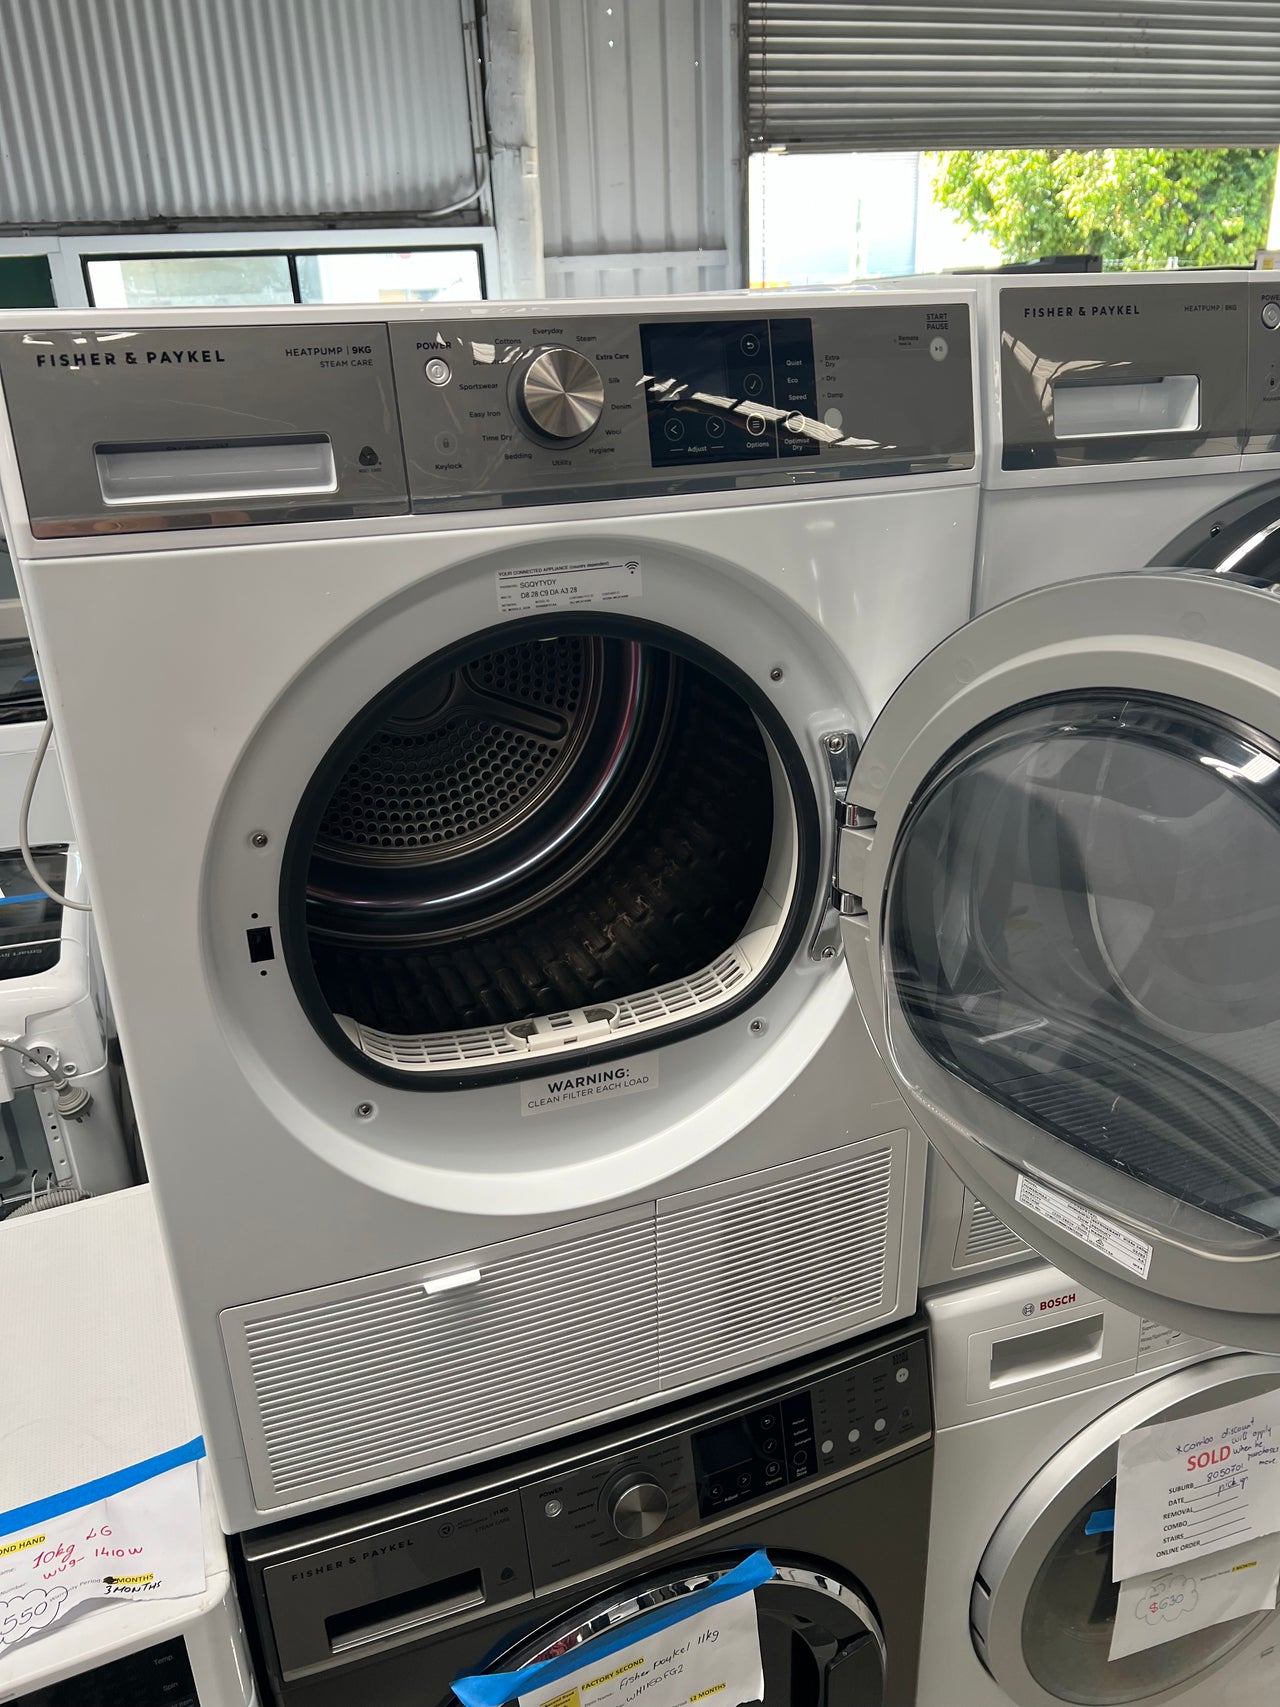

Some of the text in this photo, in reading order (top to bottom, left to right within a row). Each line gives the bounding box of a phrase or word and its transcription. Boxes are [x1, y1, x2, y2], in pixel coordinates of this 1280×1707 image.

[1024, 305, 1140, 318] FISHER & PAYKEL
[532, 327, 563, 335] Everyday
[285, 346, 372, 357] HEATPUMP 9KG
[416, 341, 452, 351] POWER
[36, 350, 226, 368] FISHER & PAYKEL
[319, 358, 374, 368] STEAM CARE
[458, 382, 499, 391] Sportswear
[469, 410, 501, 419] Easy Iron
[499, 434, 512, 442] Dry
[589, 447, 615, 455] Hygiene
[687, 444, 707, 453] Adjust
[746, 441, 770, 450] Options
[504, 453, 532, 461] Bedding
[552, 459, 572, 467] Utility
[434, 463, 463, 471] Keylock
[547, 1068, 630, 1094] WARNING:
[527, 1076, 649, 1109] CLEAN FILTER EACH LOAD
[1039, 1293, 1076, 1311] BOSCH
[1187, 1445, 1231, 1472] SOLD
[539, 1486, 563, 1498] POWER
[1168, 1482, 1194, 1495] SUBURB
[1168, 1496, 1185, 1507] DATE
[1163, 1507, 1194, 1520] REMOVAL
[1163, 1520, 1188, 1532] COMBO
[86, 1525, 113, 1541] LG
[1162, 1533, 1185, 1544] STAIRS
[18, 1535, 46, 1550] HAND
[1156, 1539, 1201, 1558] ONLINE ORDER
[32, 1542, 76, 1569] 10kg
[291, 1539, 415, 1582] FISHER & PAYKEL
[116, 1573, 154, 1584] MONTHS
[1149, 1593, 1184, 1614] $630
[581, 1657, 645, 1691] FACTORY SECOND
[698, 1682, 727, 1698] MONTHS
